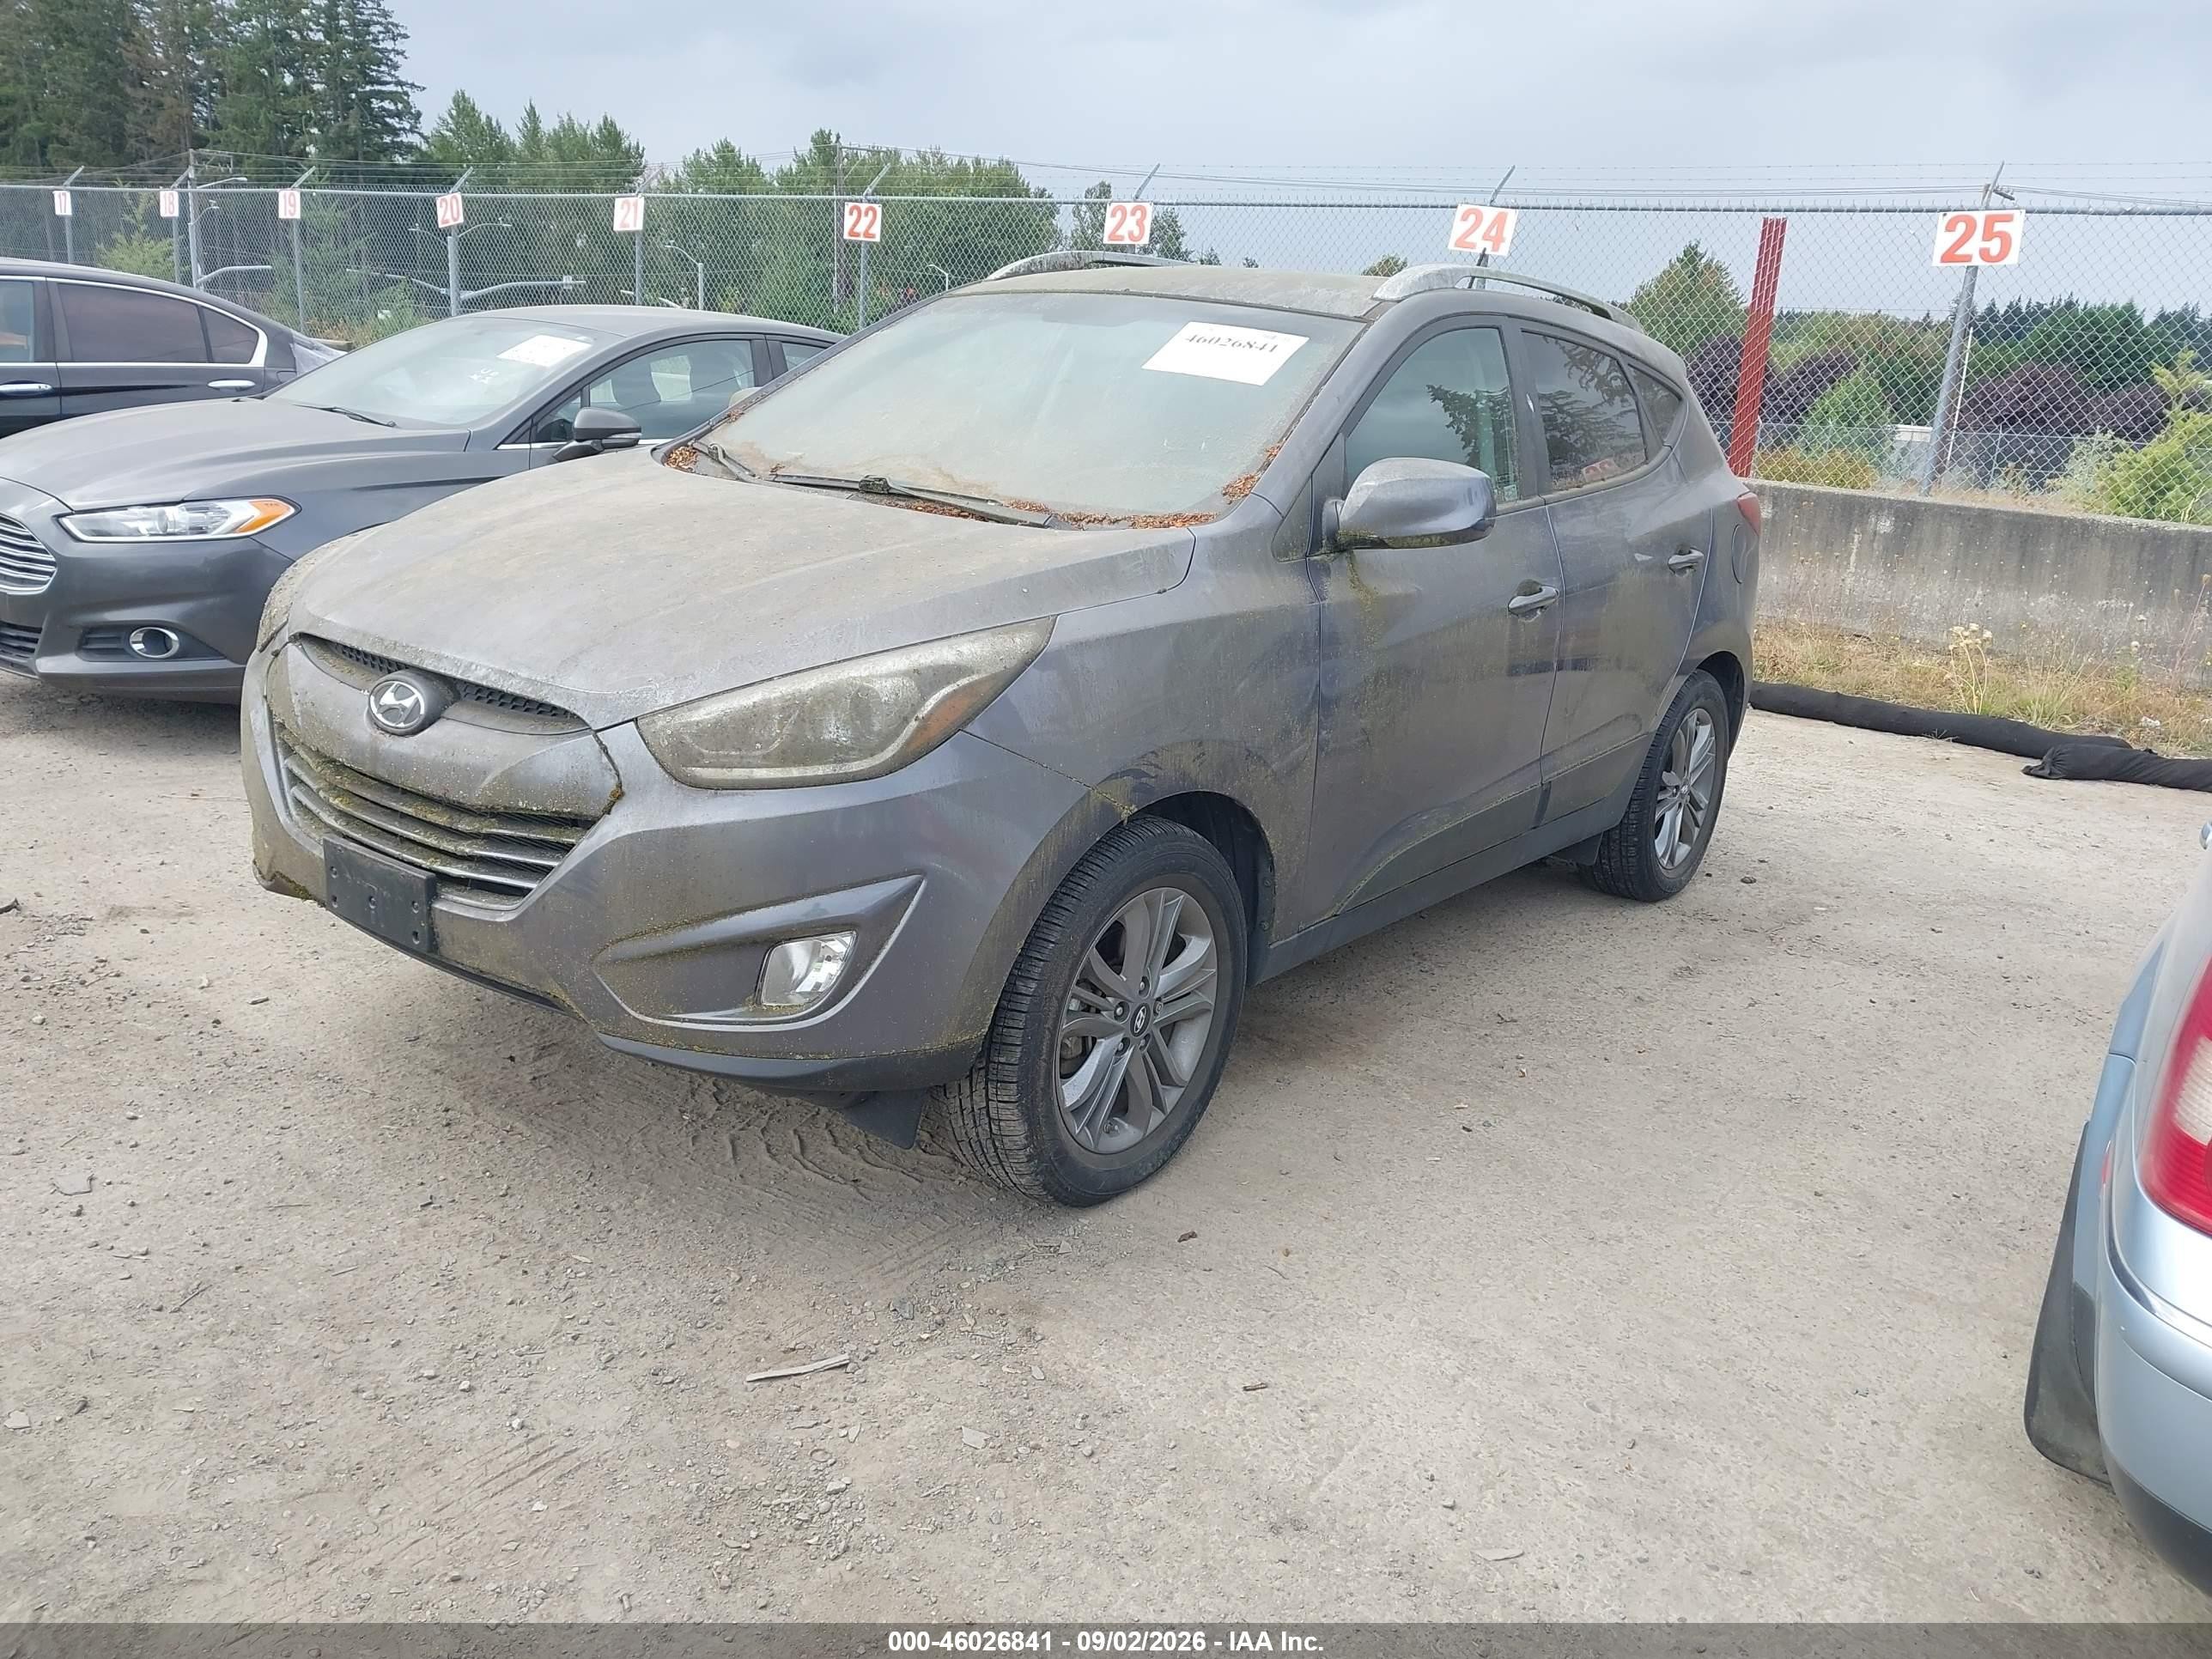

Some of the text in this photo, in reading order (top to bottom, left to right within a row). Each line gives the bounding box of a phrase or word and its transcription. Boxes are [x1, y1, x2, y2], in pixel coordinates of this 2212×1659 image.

[283, 191, 295, 217] 19
[440, 195, 459, 224] 20
[621, 198, 639, 228] 21
[848, 205, 877, 238] 22
[1108, 205, 1147, 242] 23
[1454, 208, 1508, 252] 24
[1941, 213, 2014, 263] 25
[1185, 333, 1279, 354] 46026841
